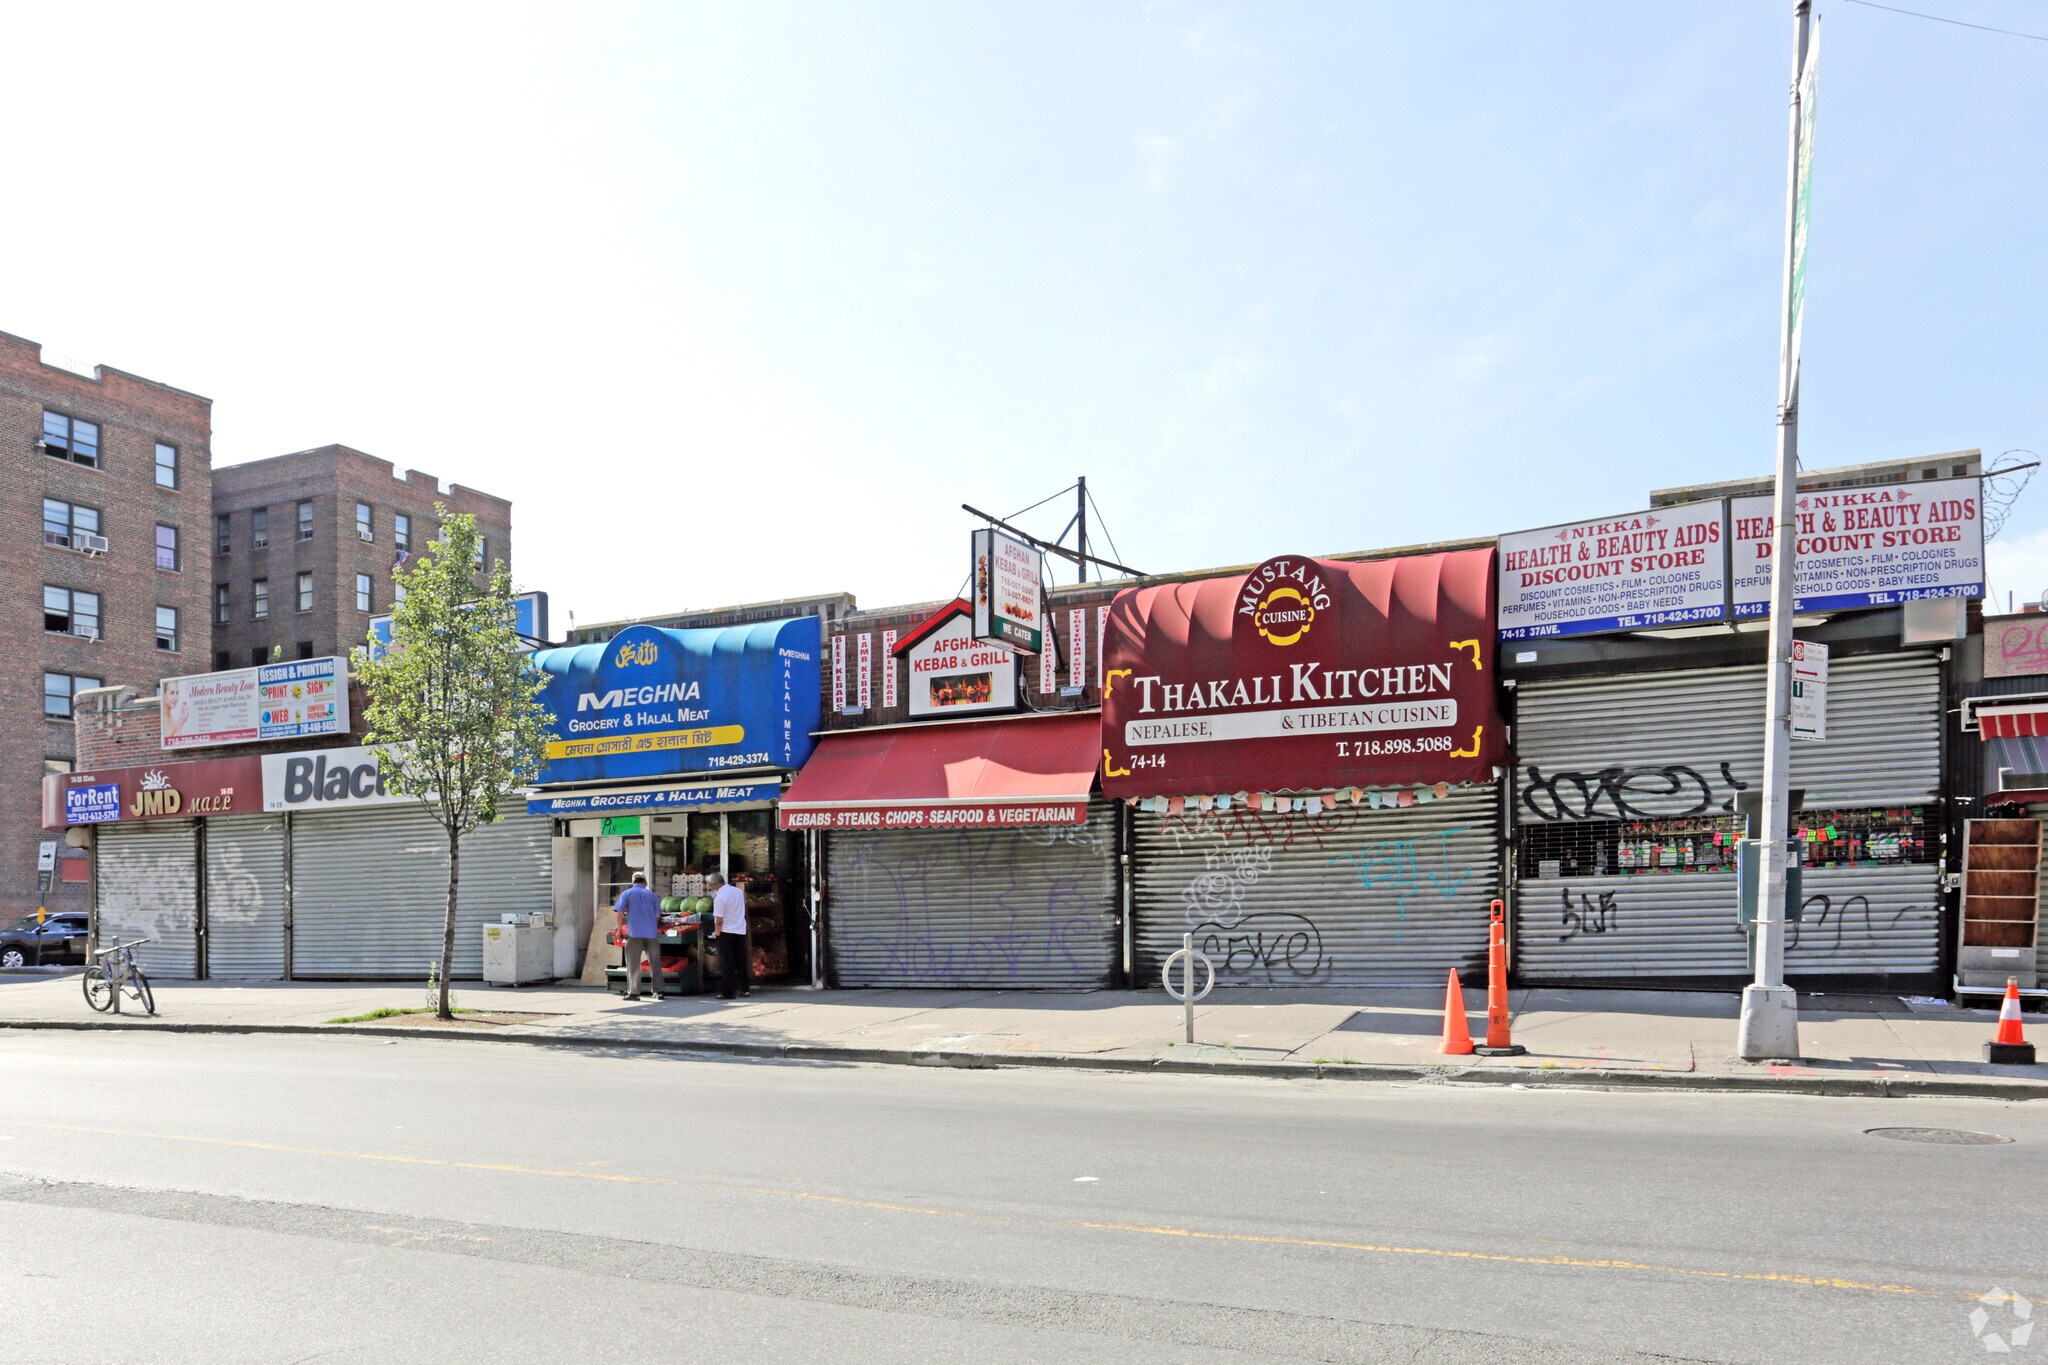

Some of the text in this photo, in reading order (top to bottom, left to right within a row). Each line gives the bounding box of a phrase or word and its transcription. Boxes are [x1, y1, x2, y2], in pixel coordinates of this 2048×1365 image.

[1813, 490, 1893, 509] NIKKA
[1571, 518, 1642, 539] NIKKA
[1736, 498, 1976, 541] HEAH & BEAUTY AIDS
[1505, 521, 1720, 571] HEALTH & BEAUTY AIDS
[1756, 525, 1961, 559] DCOUNT STORE
[1004, 543, 1030, 566] AFGHAN
[1755, 548, 1956, 575] DISNT COSMETICS FILM COLOGNES
[995, 555, 1017, 576] KEBAB
[1021, 567, 1039, 586] GRILL
[1520, 549, 1706, 588] DISCOUNT STORE
[1794, 570, 1839, 583] VITAMINS
[1846, 562, 1942, 578] NON-PRESCRIPTION
[1944, 557, 1979, 570] DRUGS
[1238, 561, 1331, 617] MUSTANG
[1520, 571, 1701, 602] DISCOUNT COSMETICS FILM COLOGNES
[1794, 572, 1940, 595] SEHOLD GOODS BABY NEEDS
[1502, 580, 1723, 615] PERFUMES VITAMINS NON-PRESCRIPTION DRUGS
[1868, 585, 1979, 605] TEL. 718-424-3700
[1262, 609, 1307, 625] CUISINE
[1534, 596, 1684, 622] HOUSEHOLD GOODS BABY NEEDS
[1617, 606, 1722, 628] TEL. 718-424-3700
[1734, 603, 1763, 615] 74-12
[1002, 622, 1032, 641] WE CATER
[1501, 627, 1526, 640] 74-12
[779, 648, 810, 661] MEGHNA
[860, 635, 869, 662] LAMB
[260, 667, 288, 682] DESIGN
[288, 666, 296, 679] &
[296, 661, 334, 678] PRINTING
[914, 650, 1009, 672] KEBAB & GRILL
[1073, 658, 1081, 685] ENTREE
[189, 680, 256, 698] Modern Beauty Zone
[267, 685, 288, 699] PRINT
[306, 680, 323, 695] SIGN
[577, 681, 700, 712] MEGHNA
[835, 668, 843, 710] KEBABS
[1133, 662, 1453, 714] THAKALI KITCHEN
[271, 709, 289, 723] WEB
[307, 704, 325, 713] COMPUTER
[307, 711, 326, 720] REPAIR
[568, 707, 710, 733] GROCERY & HALAL MEAT
[1131, 704, 1450, 741] NEPALESE, & TIBETAN CUISINE
[657, 734, 688, 747] হালাল
[692, 730, 712, 745] মিট
[1336, 736, 1452, 757] T. 718.898.5088
[708, 752, 769, 768] 718-429-3374
[1130, 753, 1166, 769] 74-14
[130, 789, 181, 817] JMD
[551, 787, 754, 809] MEGHNA GROCERY & HALAL MEAT
[77, 810, 119, 822] 347-612-5797
[788, 807, 1075, 826] KEBABS STEAKS CHOPS SEAFOOD & VEGETARIAN
